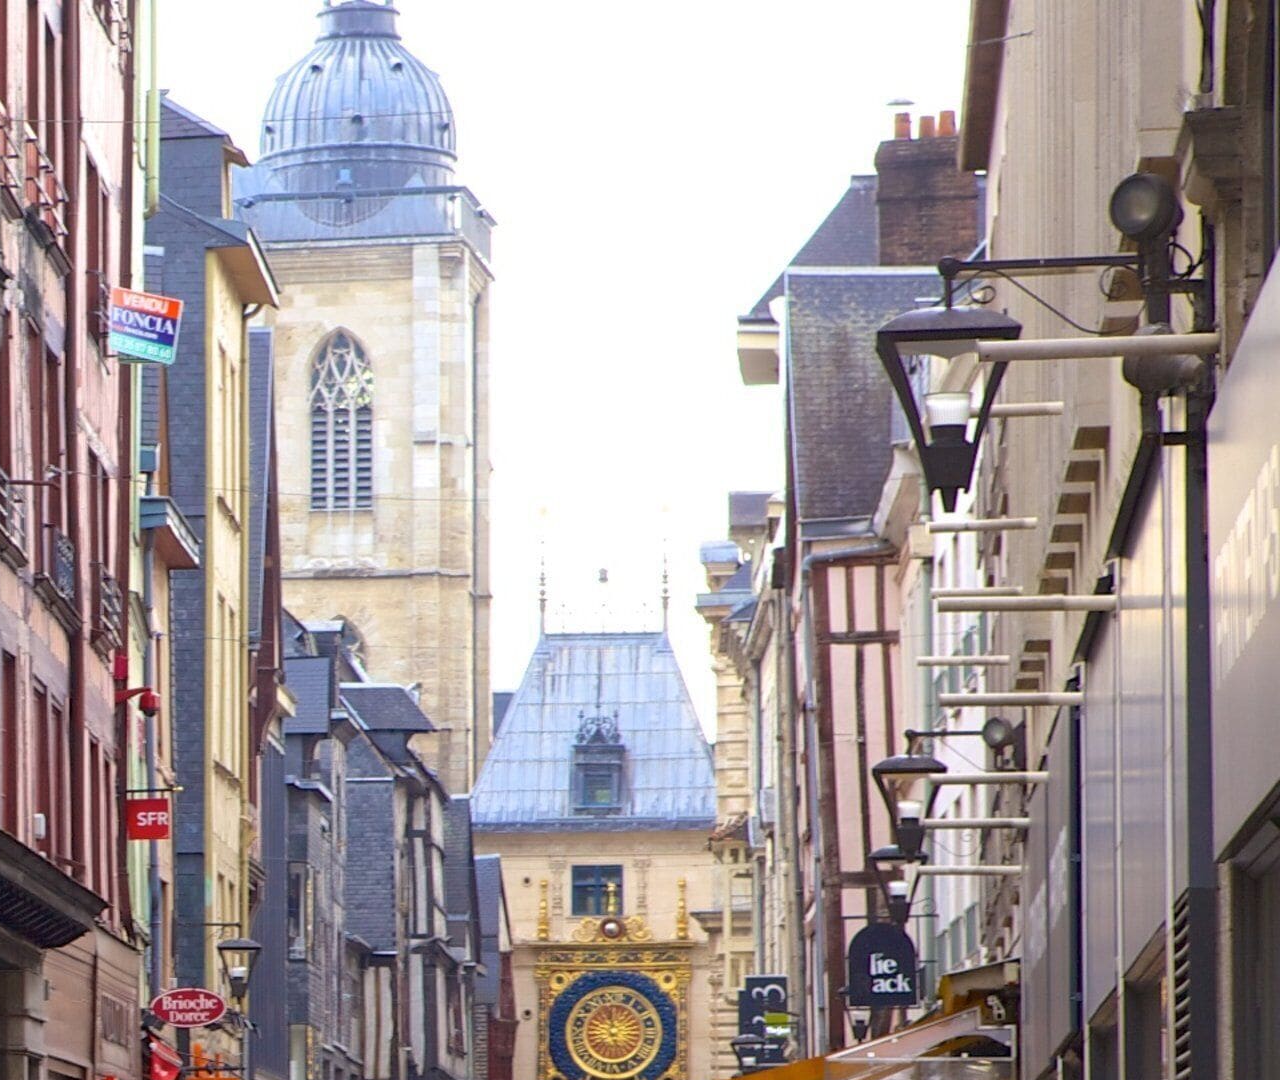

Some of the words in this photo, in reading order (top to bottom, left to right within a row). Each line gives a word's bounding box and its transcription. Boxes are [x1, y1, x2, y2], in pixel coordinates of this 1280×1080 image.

[122, 291, 170, 314] VENDU
[112, 307, 175, 335] FONCIA
[136, 811, 169, 827] SFR
[162, 994, 218, 1014] Brioche
